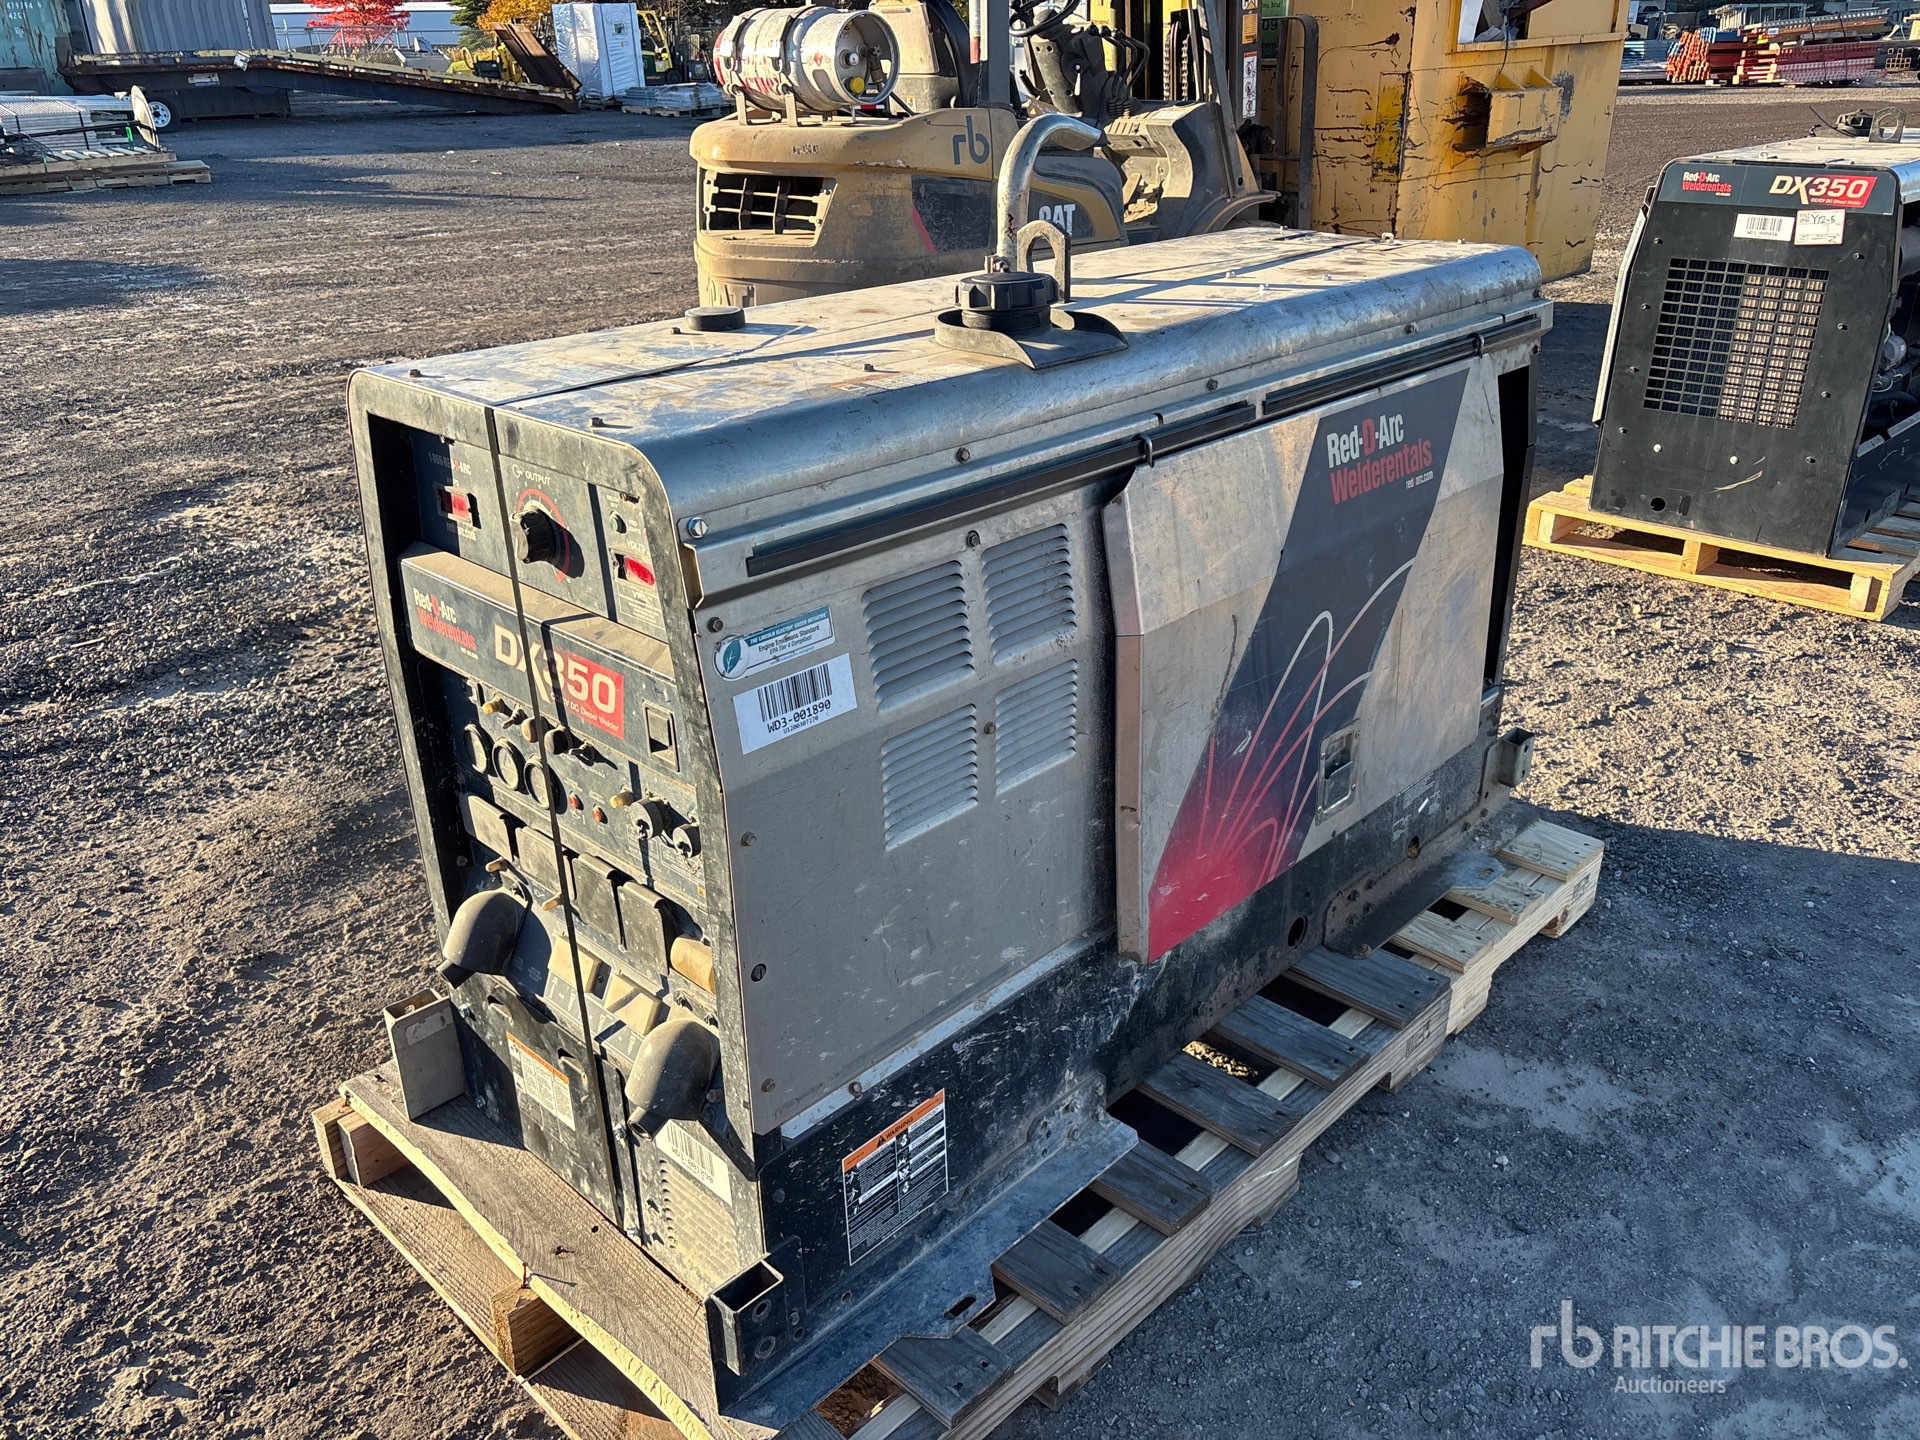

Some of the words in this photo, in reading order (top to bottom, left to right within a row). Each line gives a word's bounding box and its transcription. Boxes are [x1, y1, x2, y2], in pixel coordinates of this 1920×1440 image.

[952, 115, 990, 165] rb
[1682, 181, 1732, 193] Welderentals
[1768, 175, 1870, 205] DX350
[1326, 413, 1405, 469] Red-D-Arc
[525, 470, 552, 486] OUTPUT
[1329, 438, 1433, 506] Welderentals
[412, 587, 457, 624] Red-D-Arc
[416, 606, 478, 652] Welderentals
[758, 641, 775, 653] Engine
[799, 624, 820, 637] Standard
[494, 623, 616, 714] DX350
[769, 647, 779, 655] EPA
[767, 699, 832, 734] WD3-001890
[885, 1115, 914, 1140] WARNING
